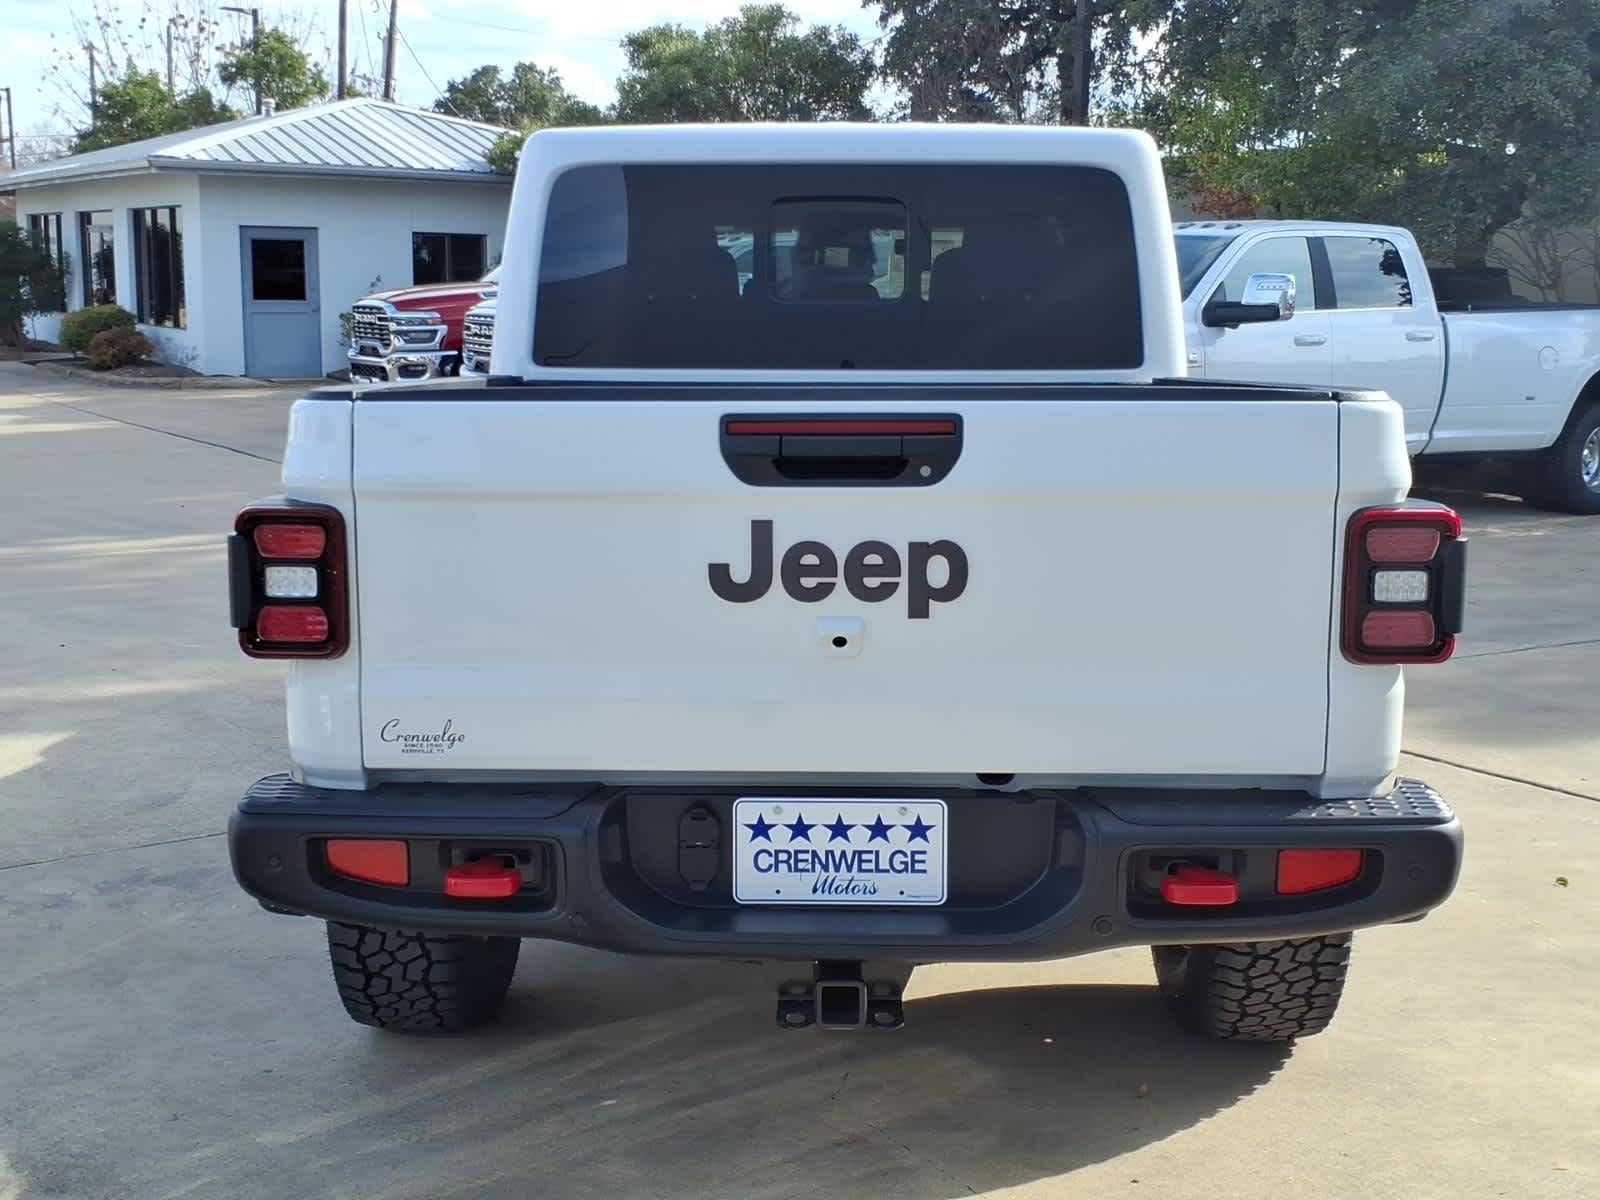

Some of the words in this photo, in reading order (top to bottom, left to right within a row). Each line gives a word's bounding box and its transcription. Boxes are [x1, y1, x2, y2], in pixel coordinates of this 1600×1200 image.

[708, 519, 969, 619] Jeep
[380, 718, 465, 749] Crenwelge
[753, 849, 927, 874] CRENWELGE
[810, 872, 880, 896] Motors
